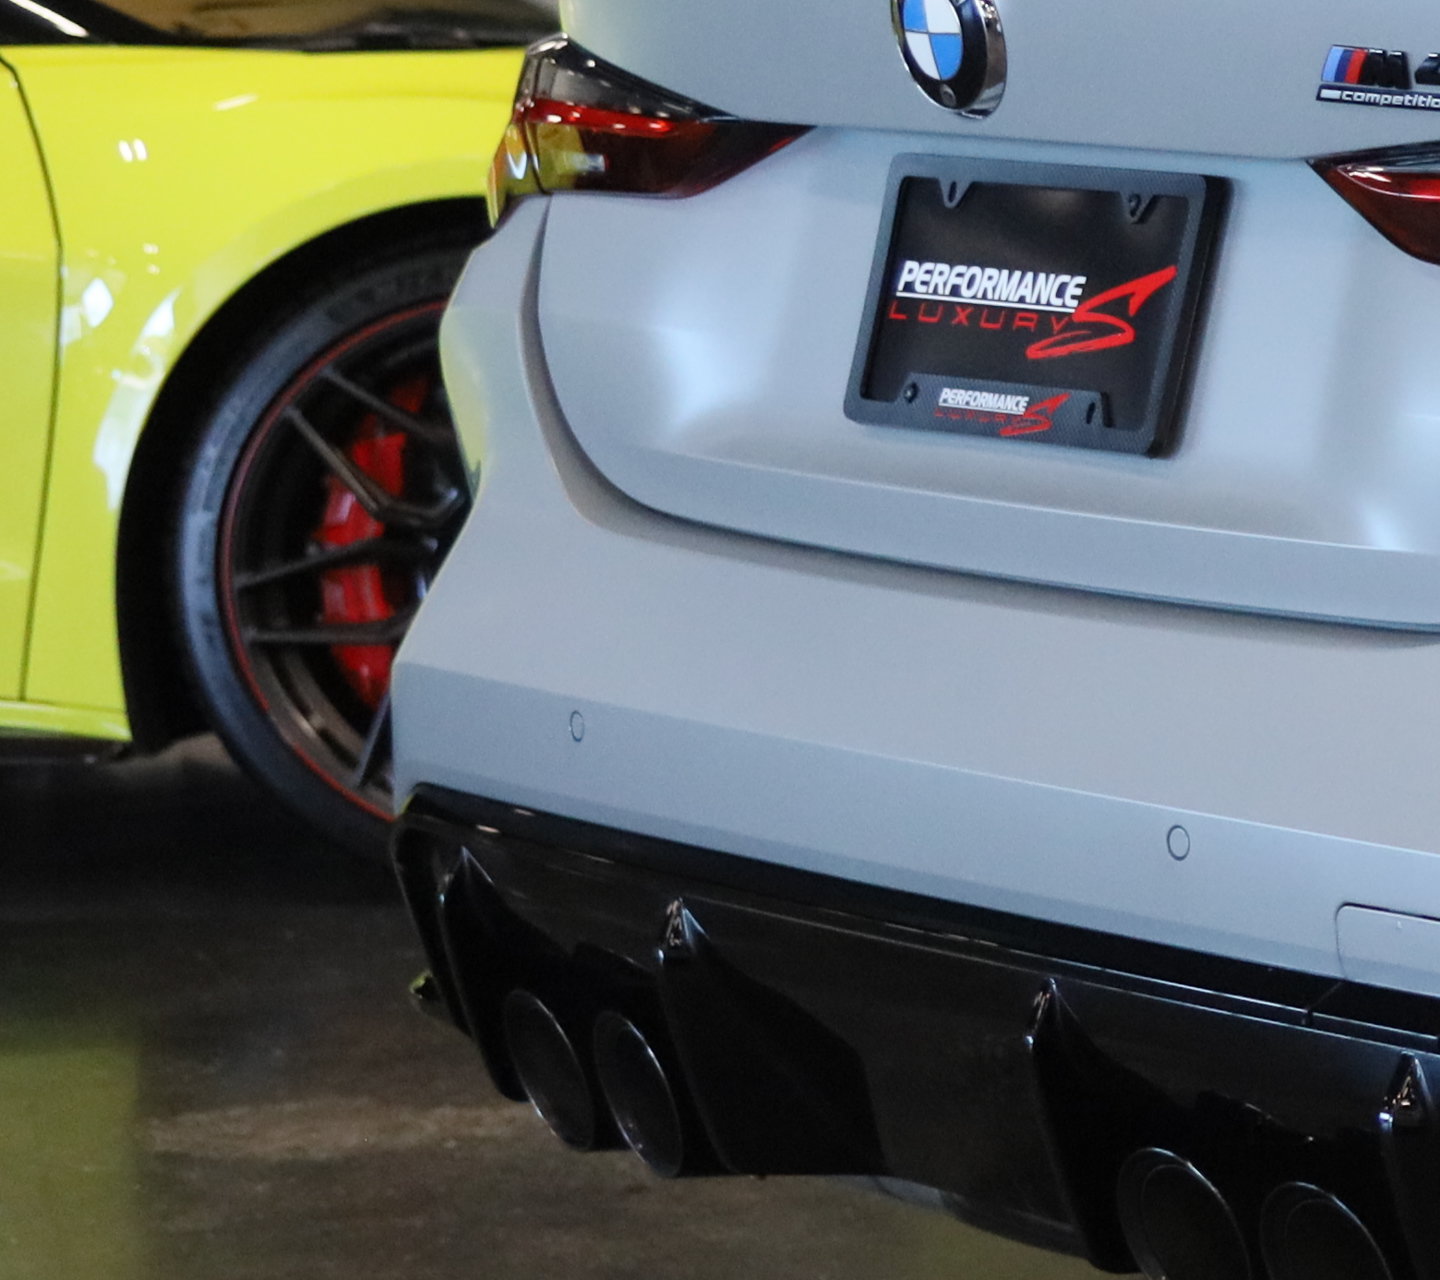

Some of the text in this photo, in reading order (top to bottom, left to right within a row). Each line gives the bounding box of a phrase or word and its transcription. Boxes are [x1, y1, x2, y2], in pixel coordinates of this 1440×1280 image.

[898, 260, 1087, 308] PERFORMANCE
[889, 301, 1070, 334] LUXURY
[938, 387, 1030, 412] PERFORMANCE
